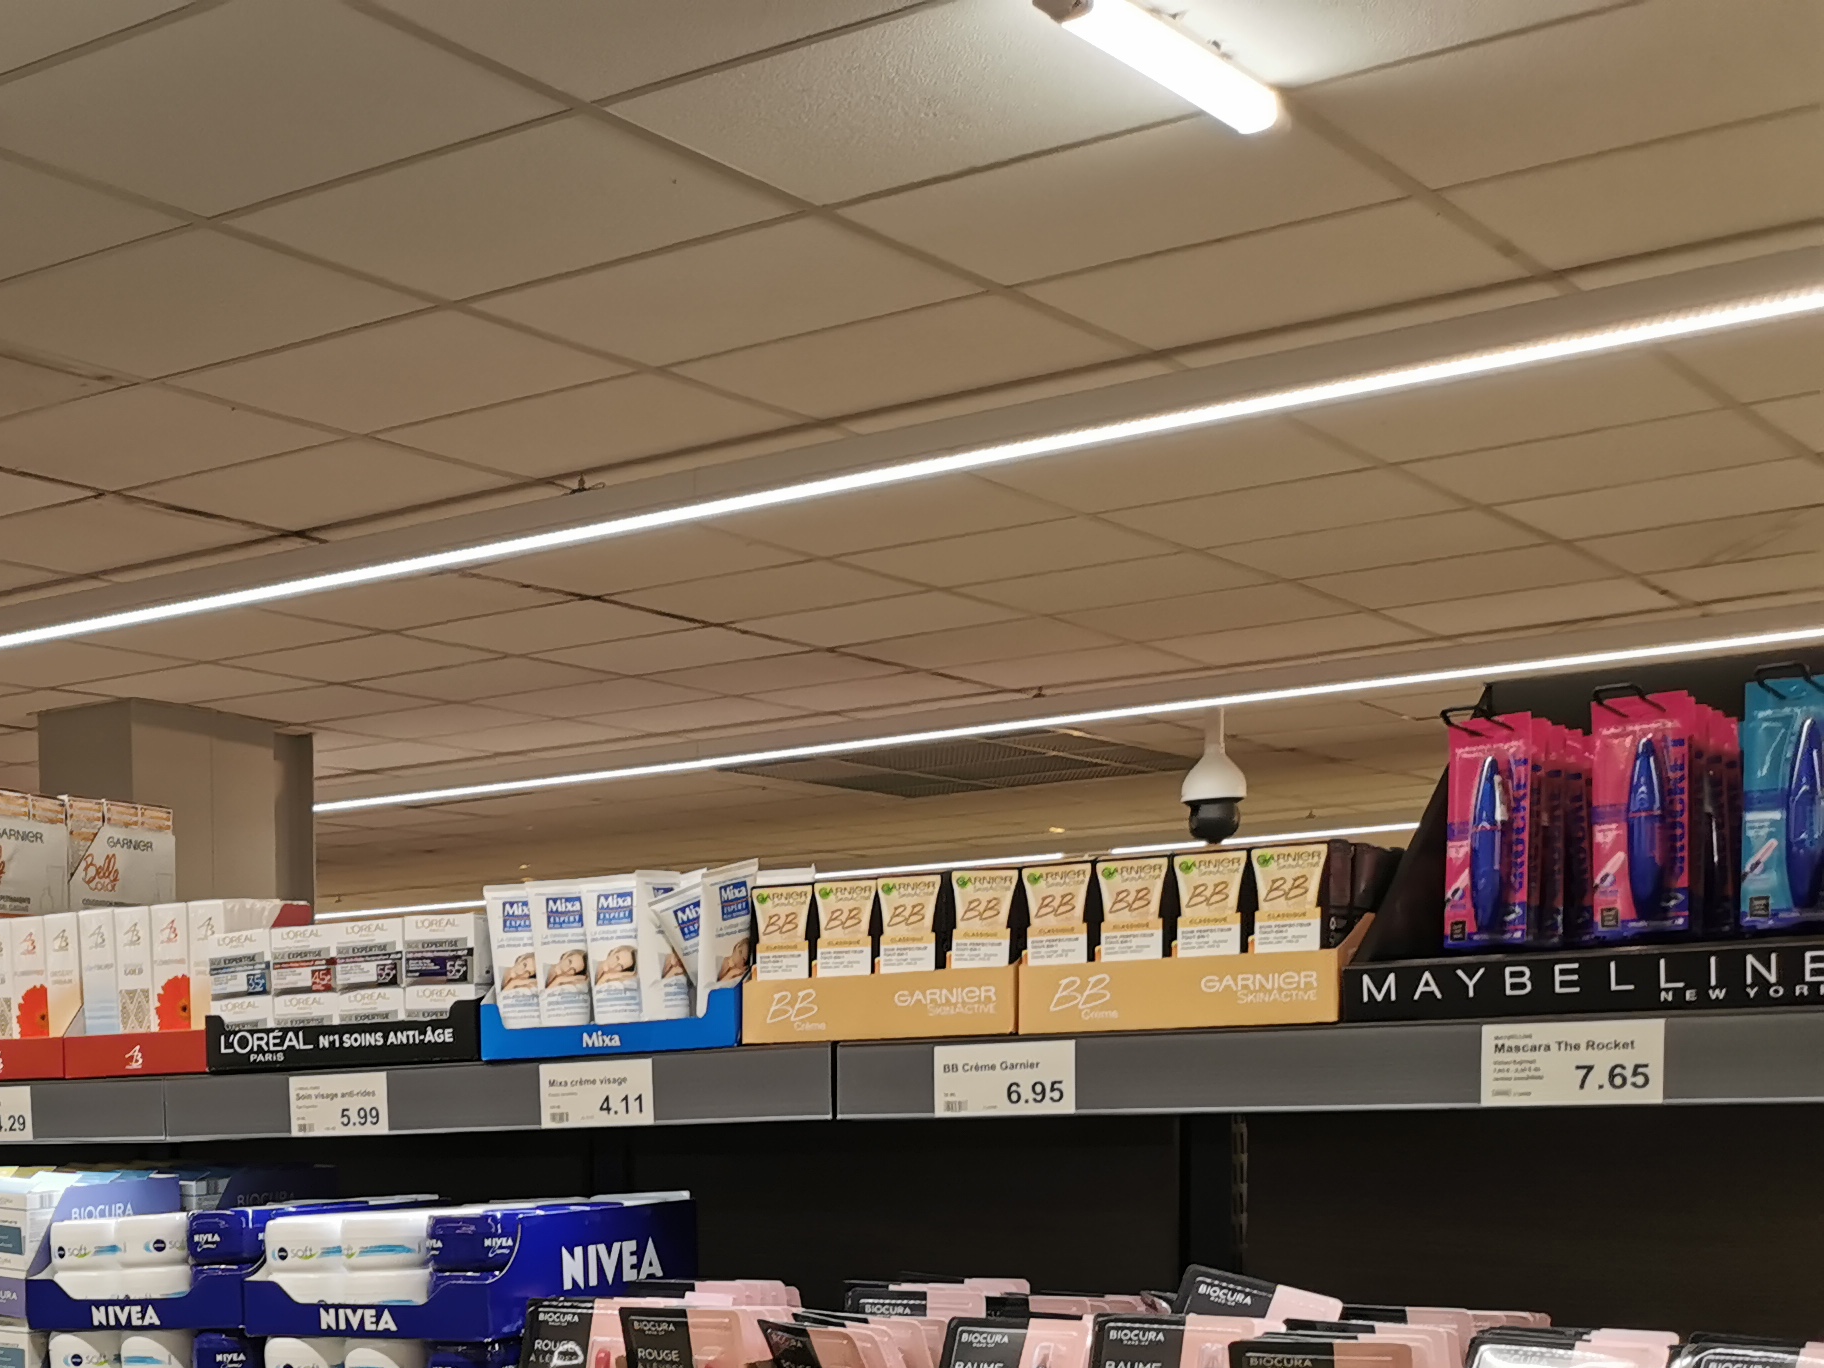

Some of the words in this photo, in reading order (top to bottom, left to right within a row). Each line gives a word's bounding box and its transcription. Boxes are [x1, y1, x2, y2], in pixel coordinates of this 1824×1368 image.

[1263, 874, 1310, 904] BB
[960, 897, 1002, 922] BB
[1200, 971, 1317, 993] GARNIER
[1362, 952, 1824, 1004] MAYBELLINE
[1050, 974, 1110, 1011] BB
[1660, 988, 1726, 1002] NEW
[343, 1031, 384, 1046] SOINS
[387, 1027, 454, 1045] ANTI-ÂGE
[582, 1032, 620, 1047] Mixa
[1493, 1041, 1551, 1054] Mascara
[1555, 1040, 1580, 1051] The
[1585, 1039, 1635, 1051] Rocket
[250, 1052, 284, 1062] PARIS
[943, 1063, 959, 1073] BB
[1000, 1059, 1040, 1070] Garnier
[1575, 1064, 1650, 1090] 7.65
[1006, 1080, 1064, 1105] 6.95
[599, 1095, 644, 1116] 4.11
[340, 1107, 379, 1127] 5.99
[563, 1237, 663, 1290] NIVEA
[1198, 1284, 1252, 1306] BIOCURA
[91, 1305, 160, 1326] NIVEA
[320, 1308, 397, 1332] NIVEA
[1109, 1331, 1165, 1343] BIOCURA
[638, 1349, 679, 1360] ROUGE
